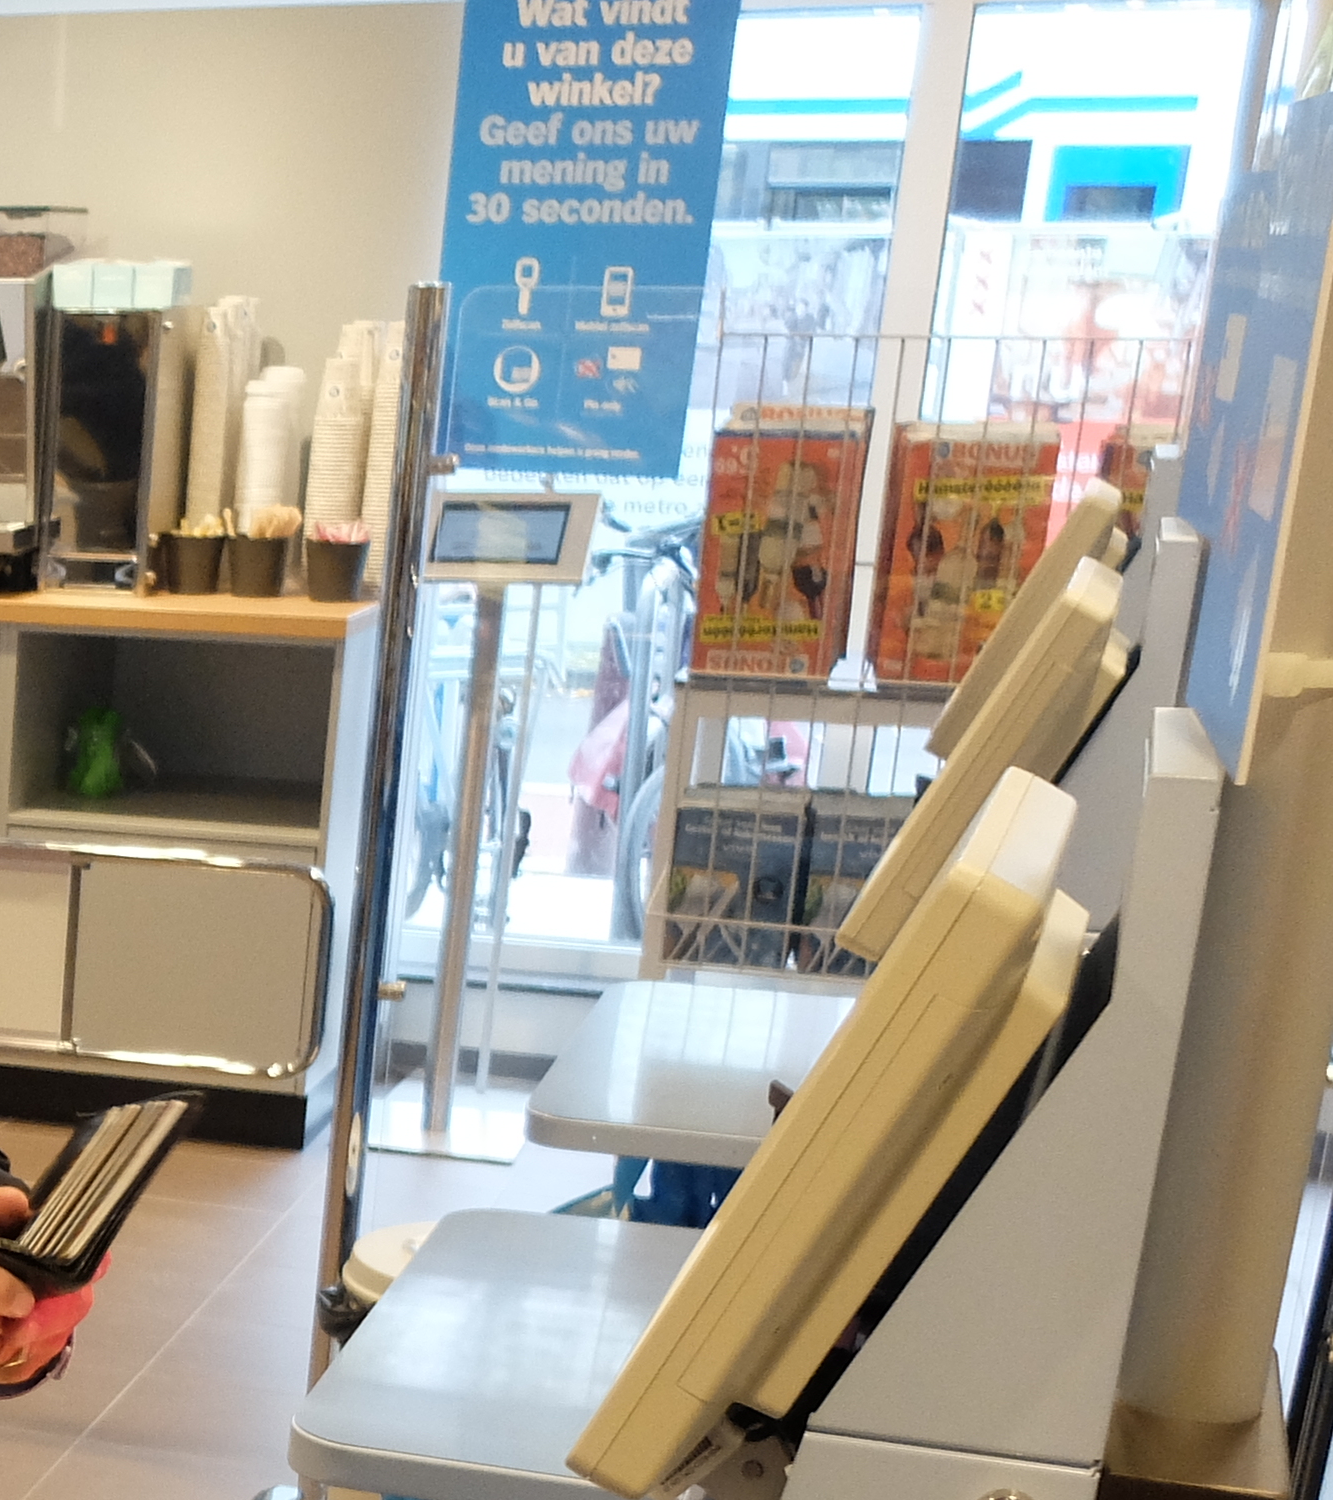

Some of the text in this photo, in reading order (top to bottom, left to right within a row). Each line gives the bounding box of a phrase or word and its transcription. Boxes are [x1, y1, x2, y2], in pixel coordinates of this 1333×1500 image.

[518, 0, 688, 27] Wat vindt
[502, 31, 694, 68] u van deze
[528, 71, 661, 106] winkel?
[480, 112, 700, 146] Geef ons uw
[499, 151, 669, 192] mening in
[466, 191, 694, 224] 30 seconden.
